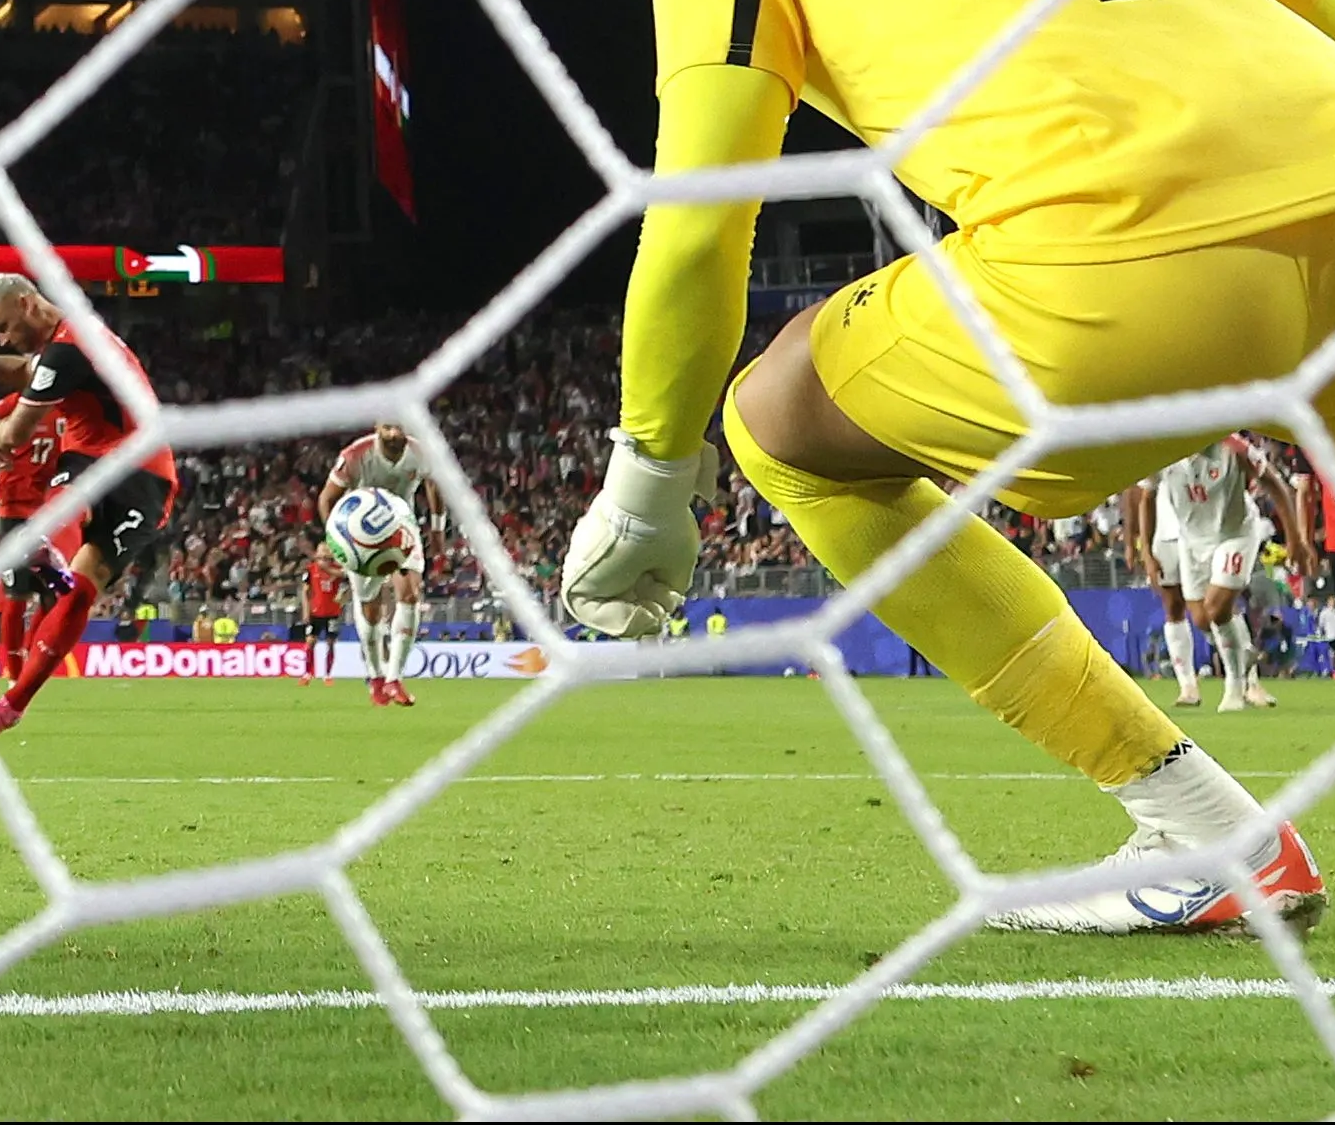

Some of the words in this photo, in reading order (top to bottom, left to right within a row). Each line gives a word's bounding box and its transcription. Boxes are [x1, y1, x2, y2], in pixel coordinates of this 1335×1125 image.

[29, 437, 54, 465] 17
[85, 644, 307, 677] McDonald's
[404, 644, 491, 678] Dove
